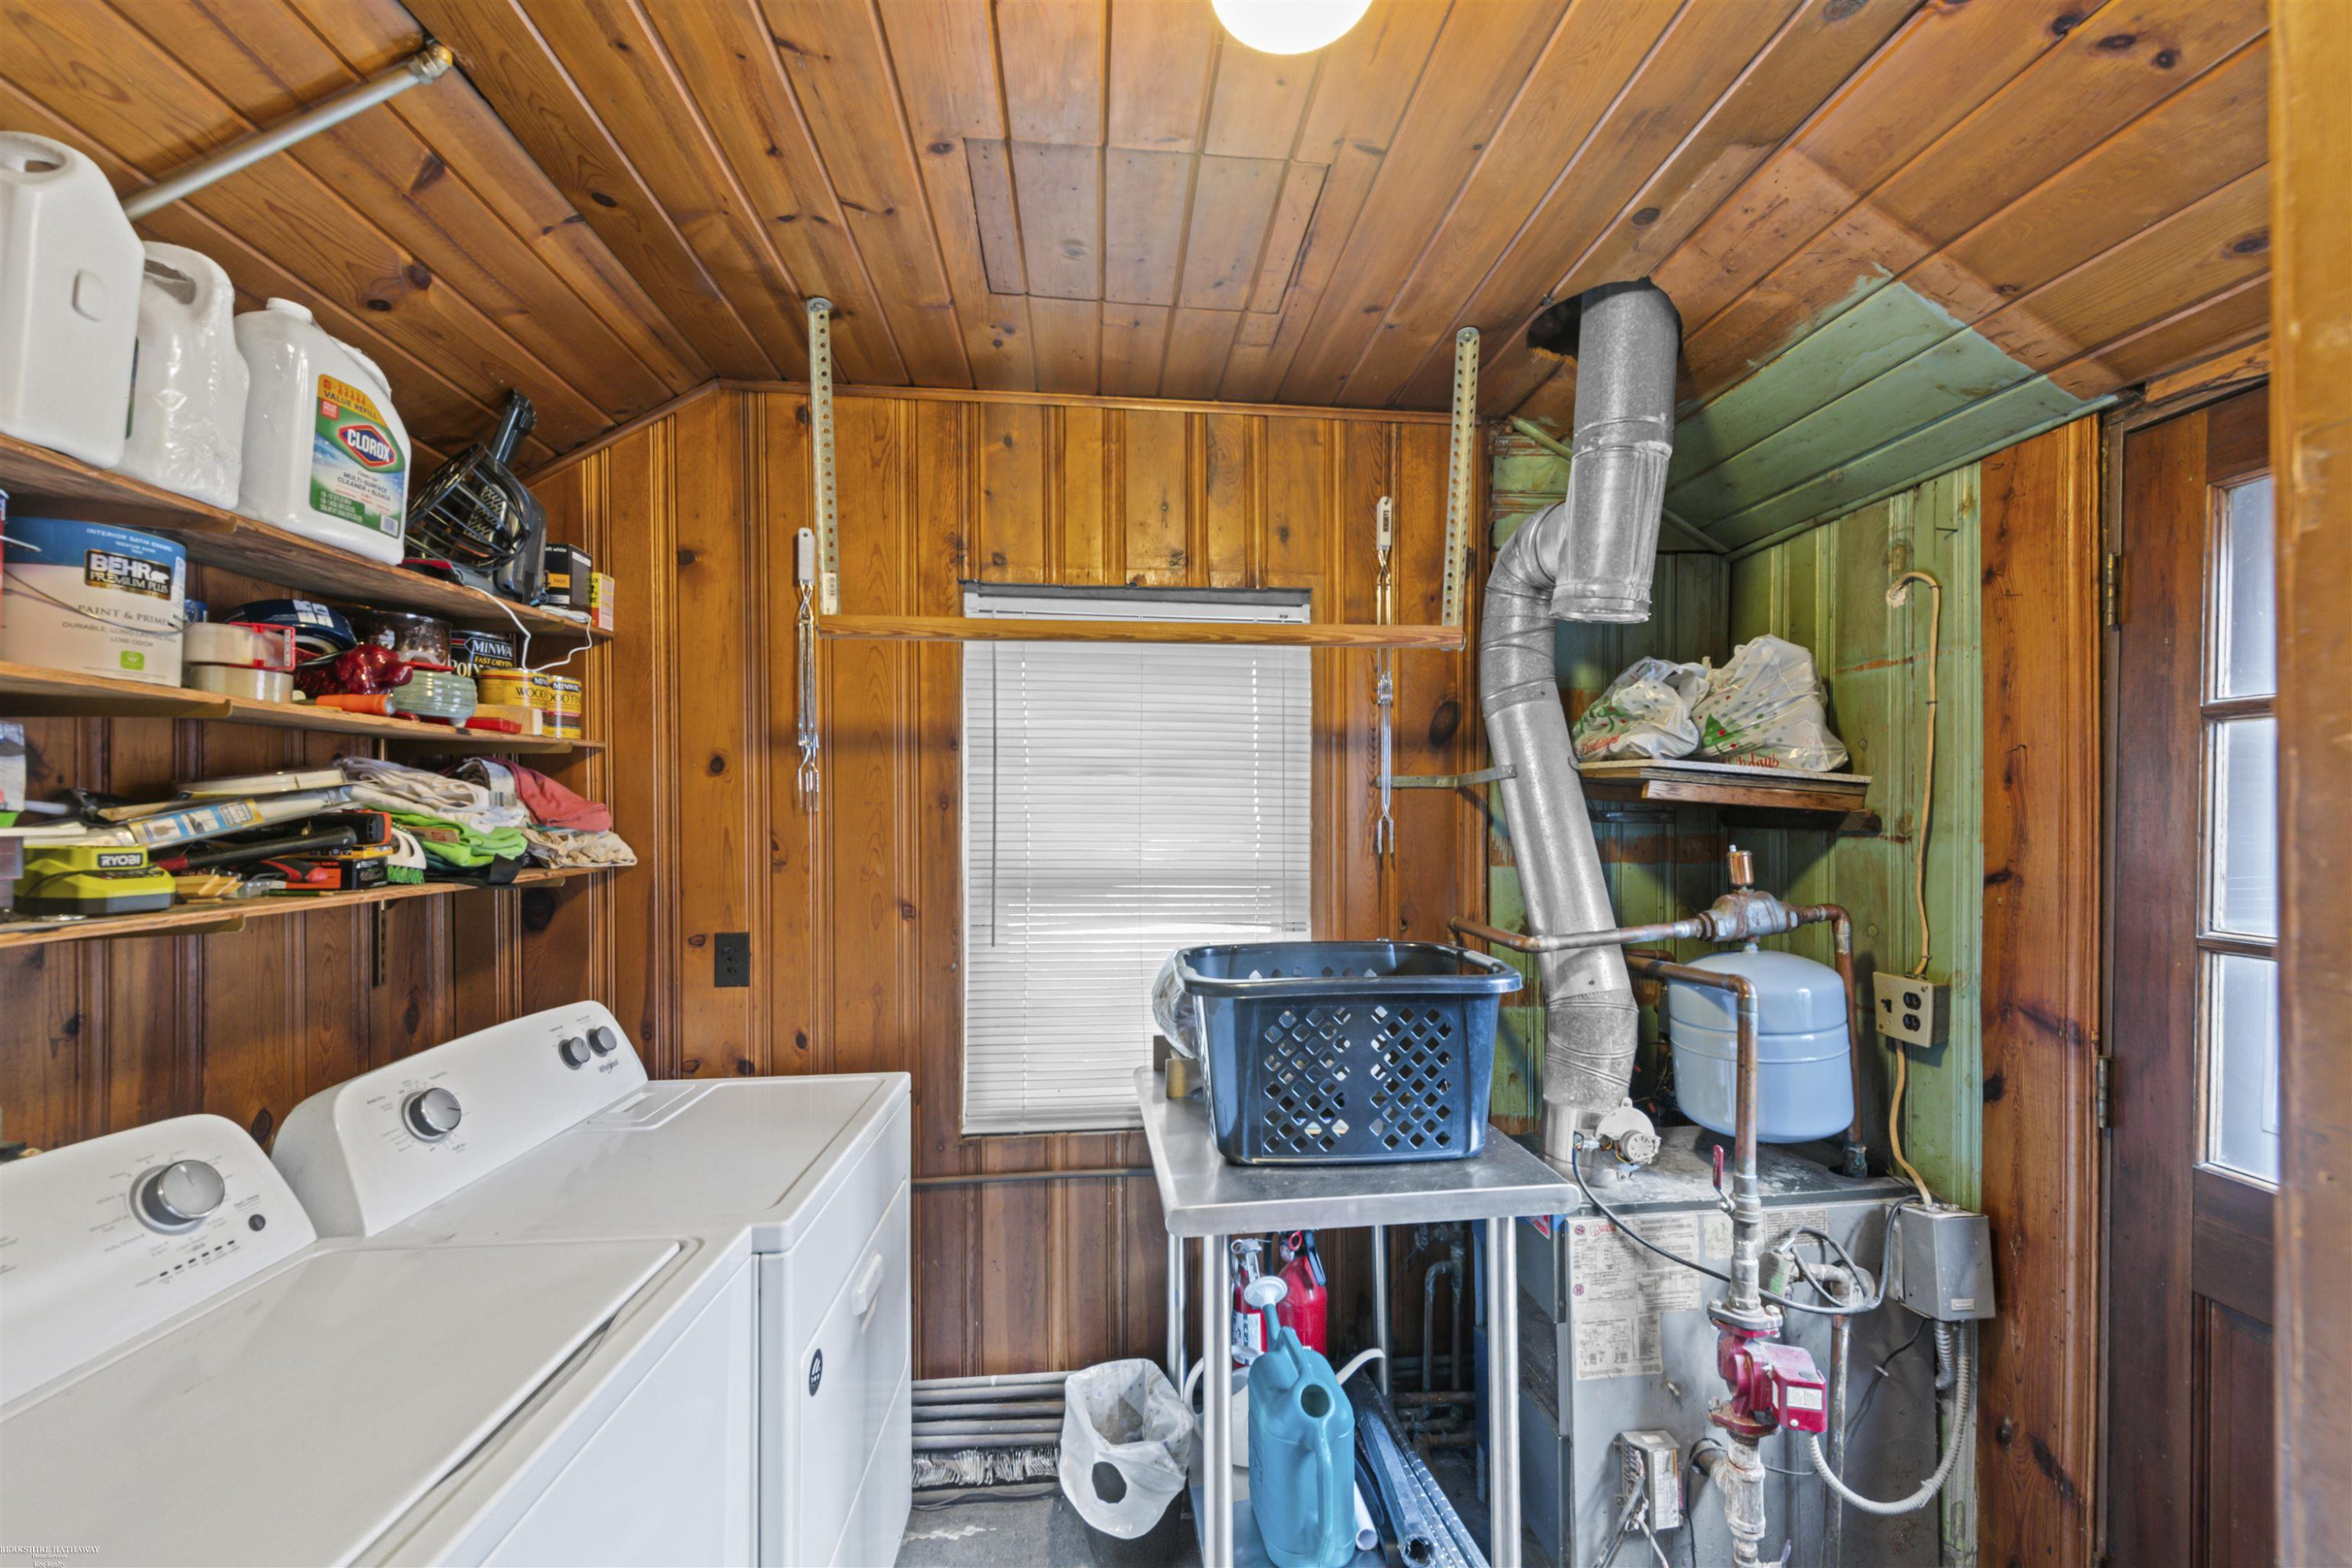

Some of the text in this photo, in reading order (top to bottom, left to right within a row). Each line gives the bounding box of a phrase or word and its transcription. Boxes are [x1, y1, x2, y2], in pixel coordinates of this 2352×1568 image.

[324, 390, 351, 407] VALUE
[347, 428, 390, 463] CLOROX
[337, 477, 366, 492] CLEANER
[86, 528, 128, 540] INTERIOR
[89, 553, 152, 582] BEHR
[89, 571, 169, 593] PREMIUM PLUS
[78, 604, 121, 618] PAINT
[124, 612, 132, 620] &
[472, 639, 514, 657] MINWA
[100, 854, 141, 866] RYOBI
